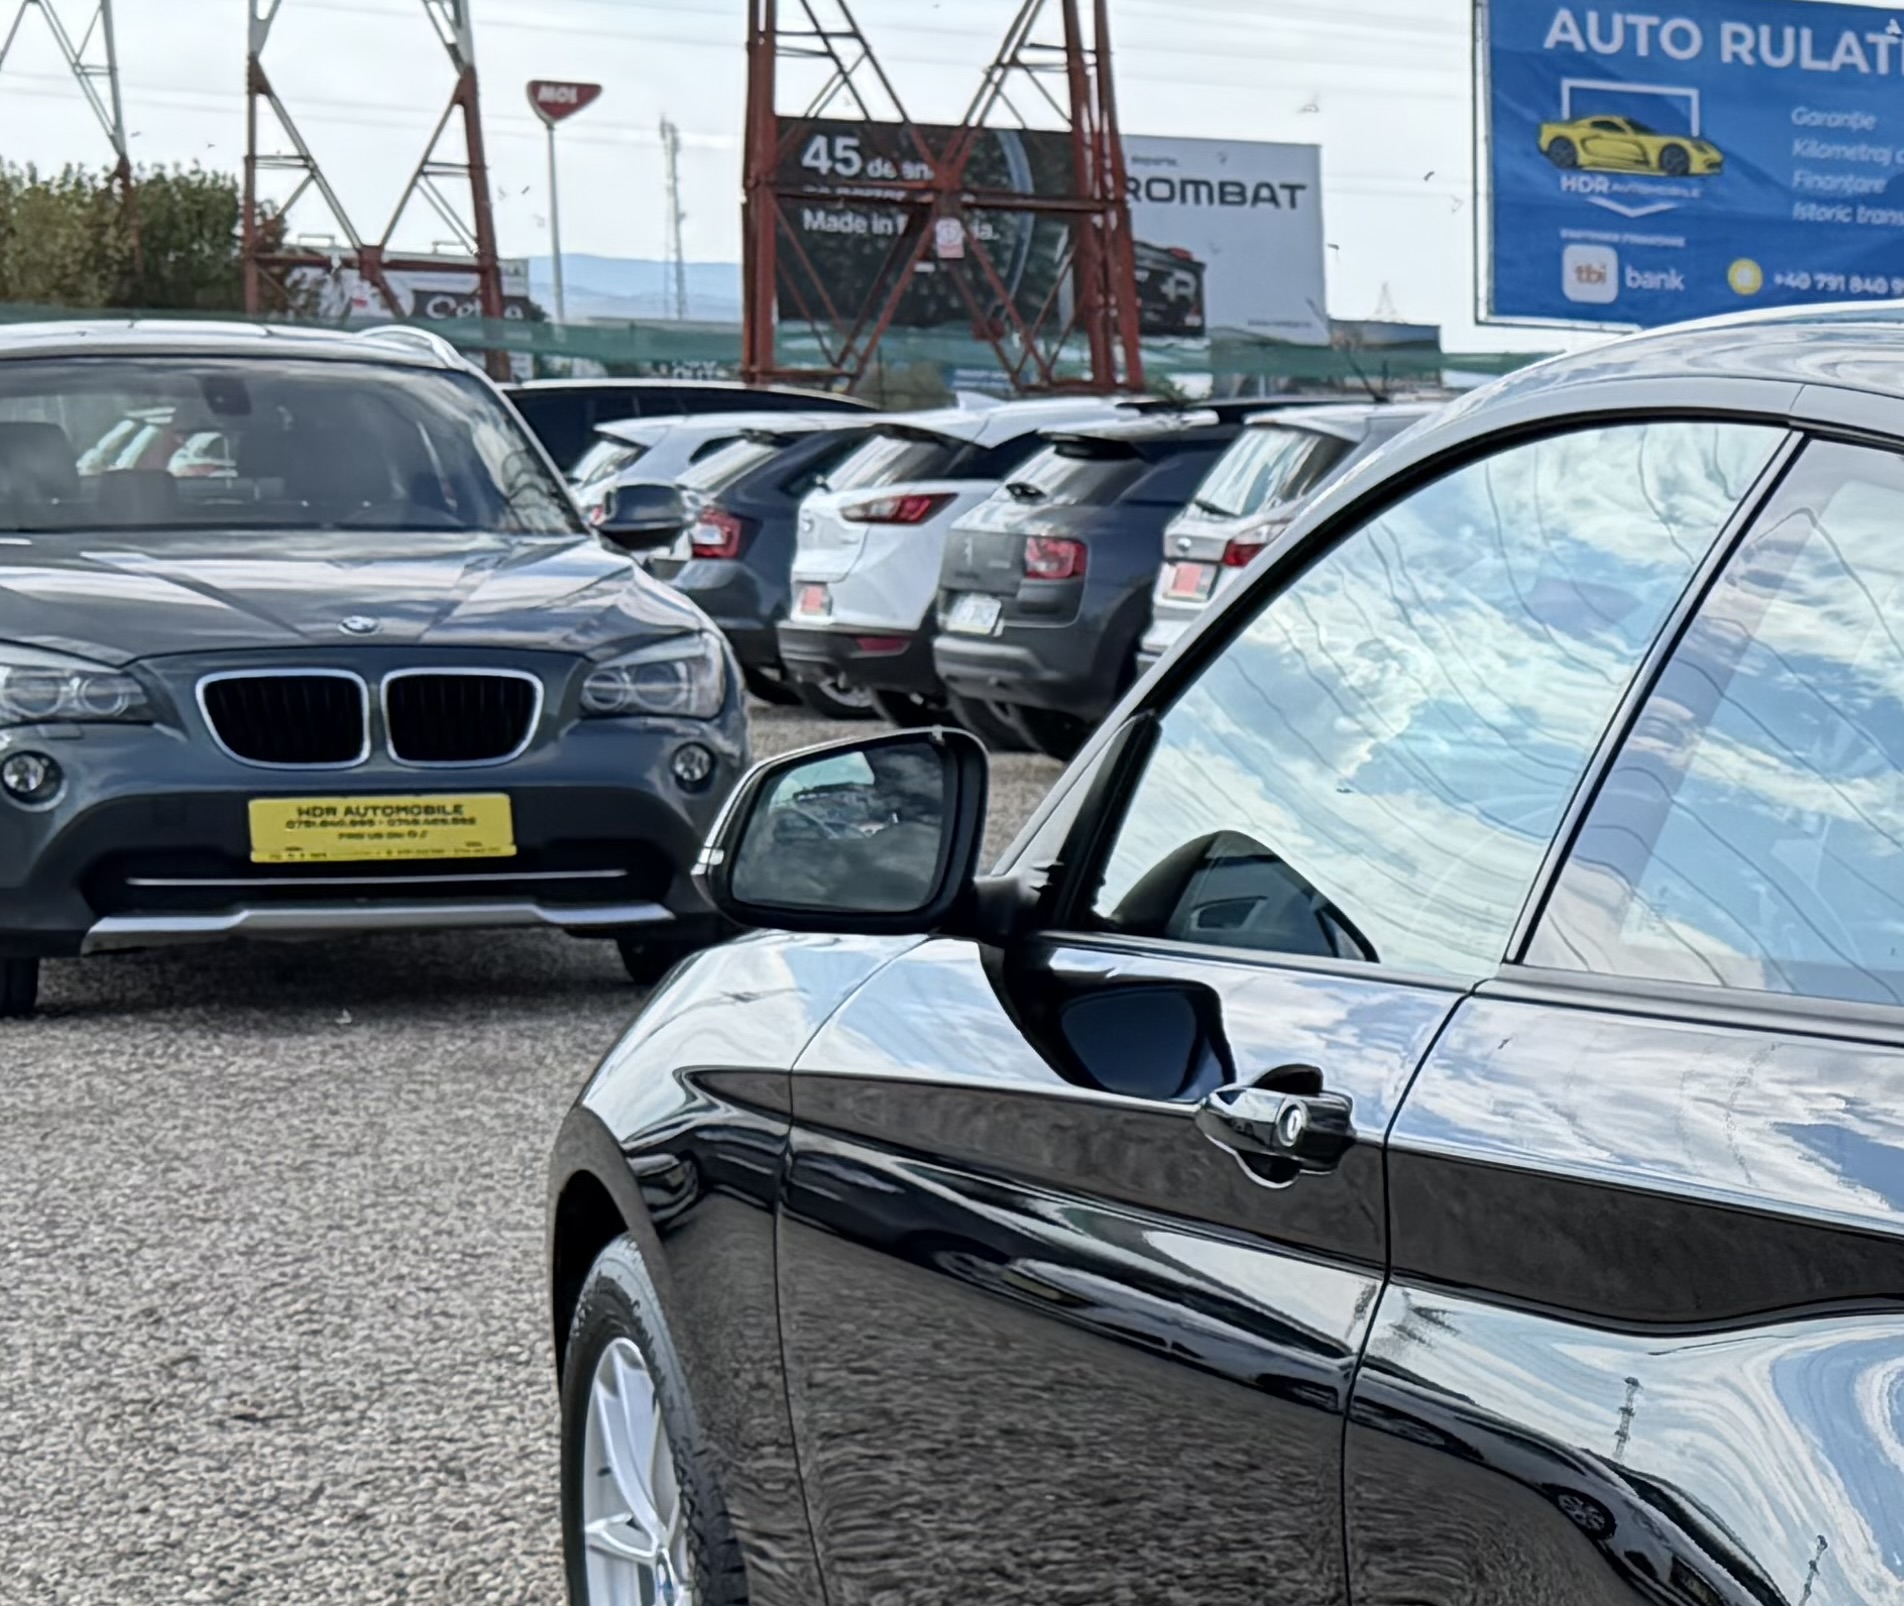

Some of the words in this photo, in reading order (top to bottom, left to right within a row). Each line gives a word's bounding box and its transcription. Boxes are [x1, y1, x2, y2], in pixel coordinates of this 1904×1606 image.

[1543, 8, 1702, 61] AUTO
[537, 86, 578, 104] MOL
[801, 134, 863, 177] 45
[1560, 174, 1609, 194] HDR
[803, 209, 867, 234] Made
[872, 211, 892, 235] in
[1793, 202, 1853, 224] Istoric
[1575, 264, 1607, 285] tbi
[1625, 265, 1685, 291] bank
[297, 805, 338, 819] HDR
[344, 804, 464, 818] AUTOMOBILE
